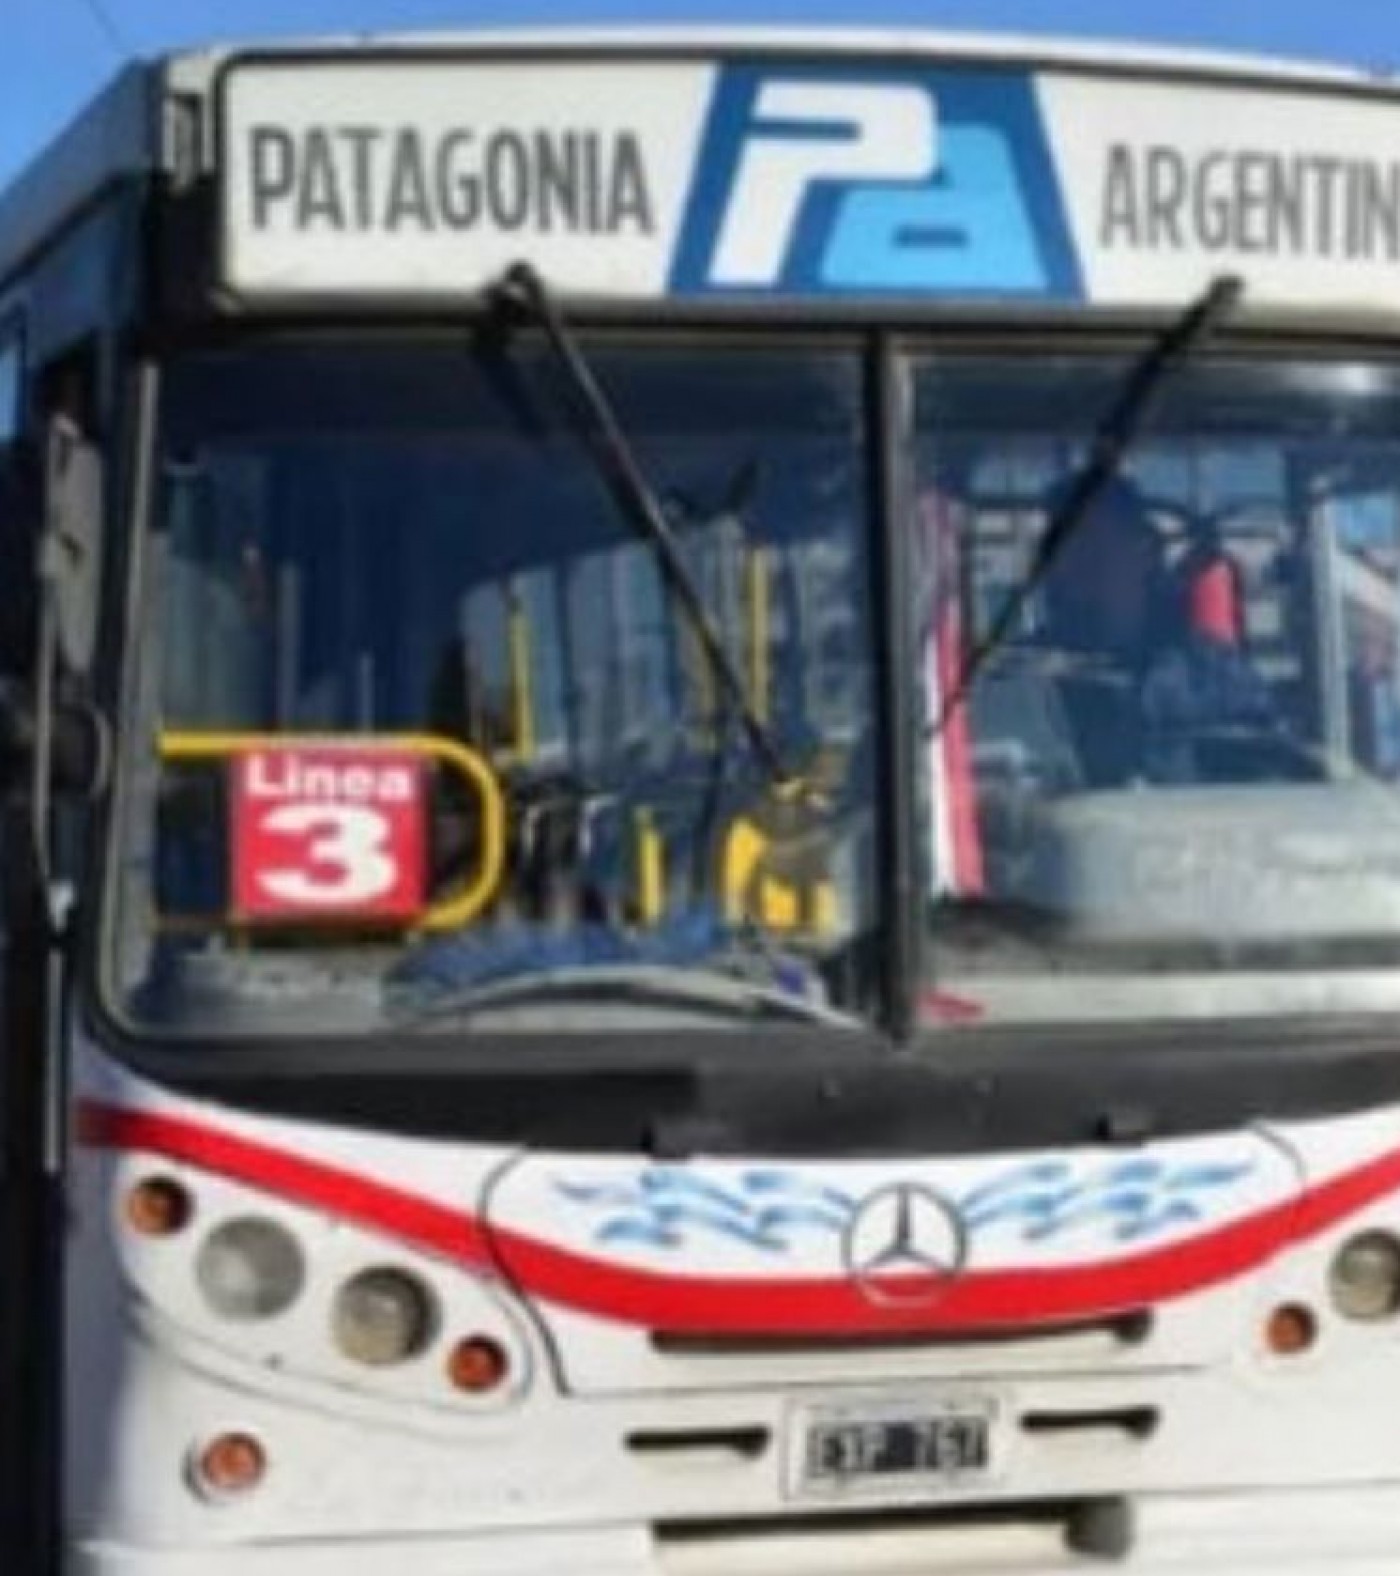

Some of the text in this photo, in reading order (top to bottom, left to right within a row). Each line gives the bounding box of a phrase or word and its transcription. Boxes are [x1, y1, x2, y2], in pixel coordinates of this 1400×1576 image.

[249, 125, 654, 236] PATAGONIA
[245, 752, 412, 800] Linea
[257, 803, 398, 906] 3
